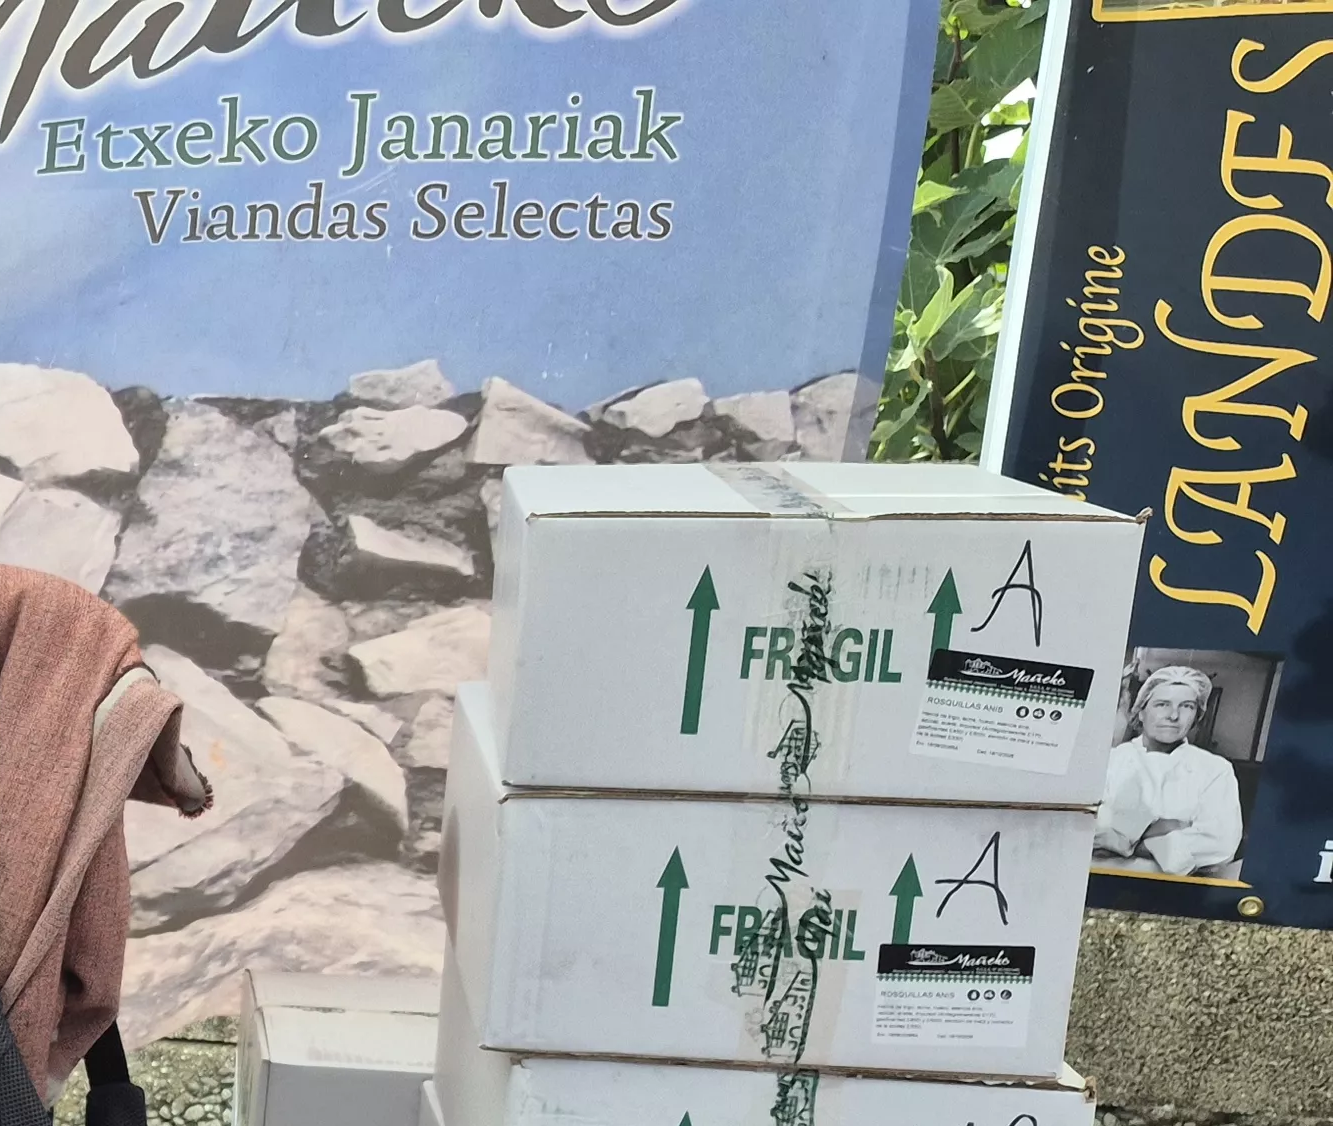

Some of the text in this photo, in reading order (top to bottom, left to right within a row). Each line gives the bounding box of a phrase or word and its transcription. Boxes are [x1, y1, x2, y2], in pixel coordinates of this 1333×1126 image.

[36, 88, 683, 177] Etxeko Janariak
[133, 180, 674, 245] Viandas Selectas
[1051, 245, 1145, 419] Origine
[971, 540, 1044, 646] A
[927, 696, 982, 711] ROSQUILLAS
[935, 831, 1008, 925] A
